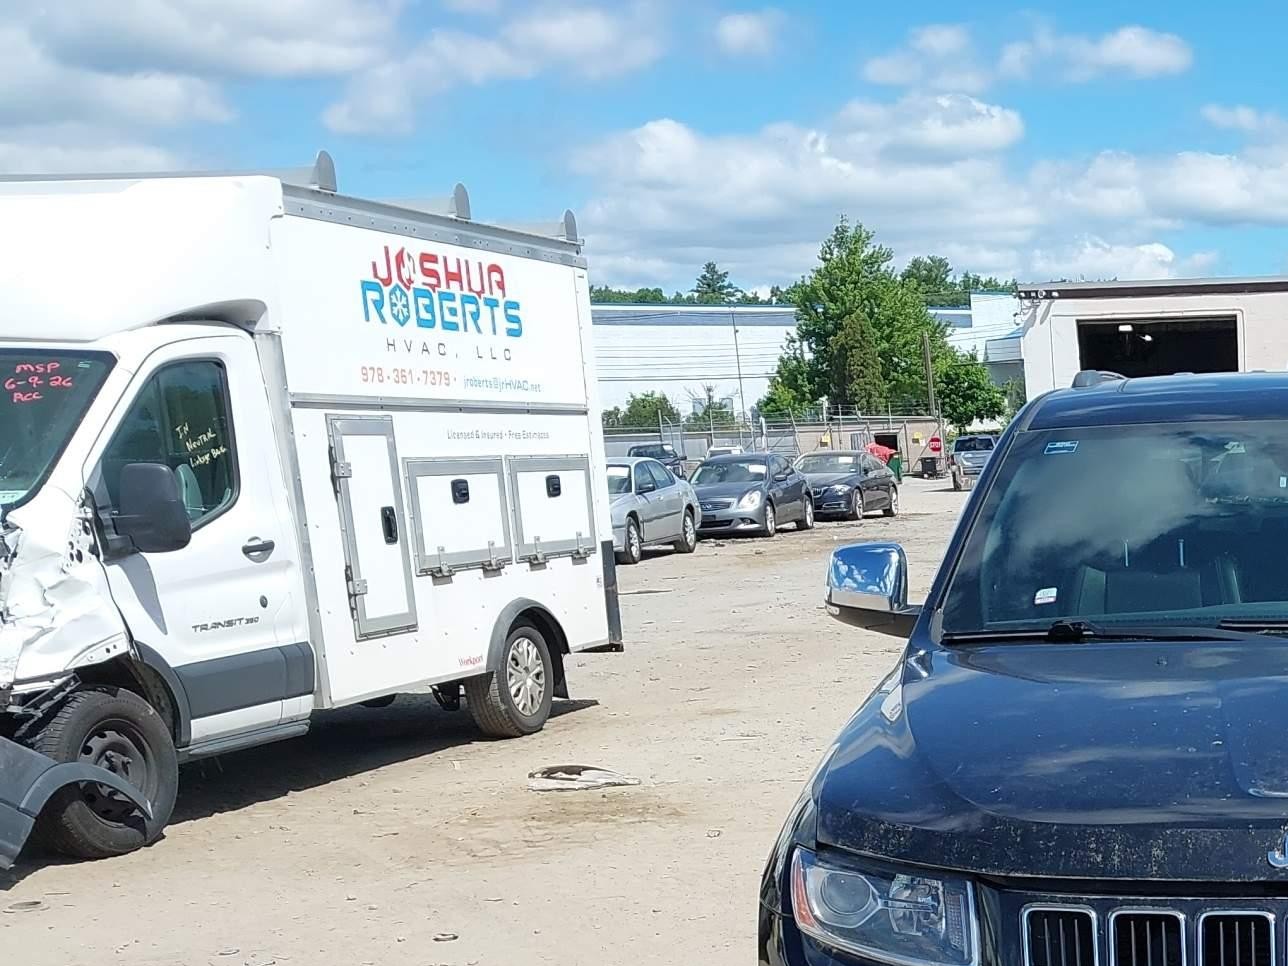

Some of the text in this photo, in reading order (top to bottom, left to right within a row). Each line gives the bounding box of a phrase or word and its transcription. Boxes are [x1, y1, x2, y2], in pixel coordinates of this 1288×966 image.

[372, 246, 506, 299] JOSHUA
[360, 280, 523, 338] ROBERTS
[476, 345, 512, 361] LLC
[192, 617, 244, 633] TRANSIT
